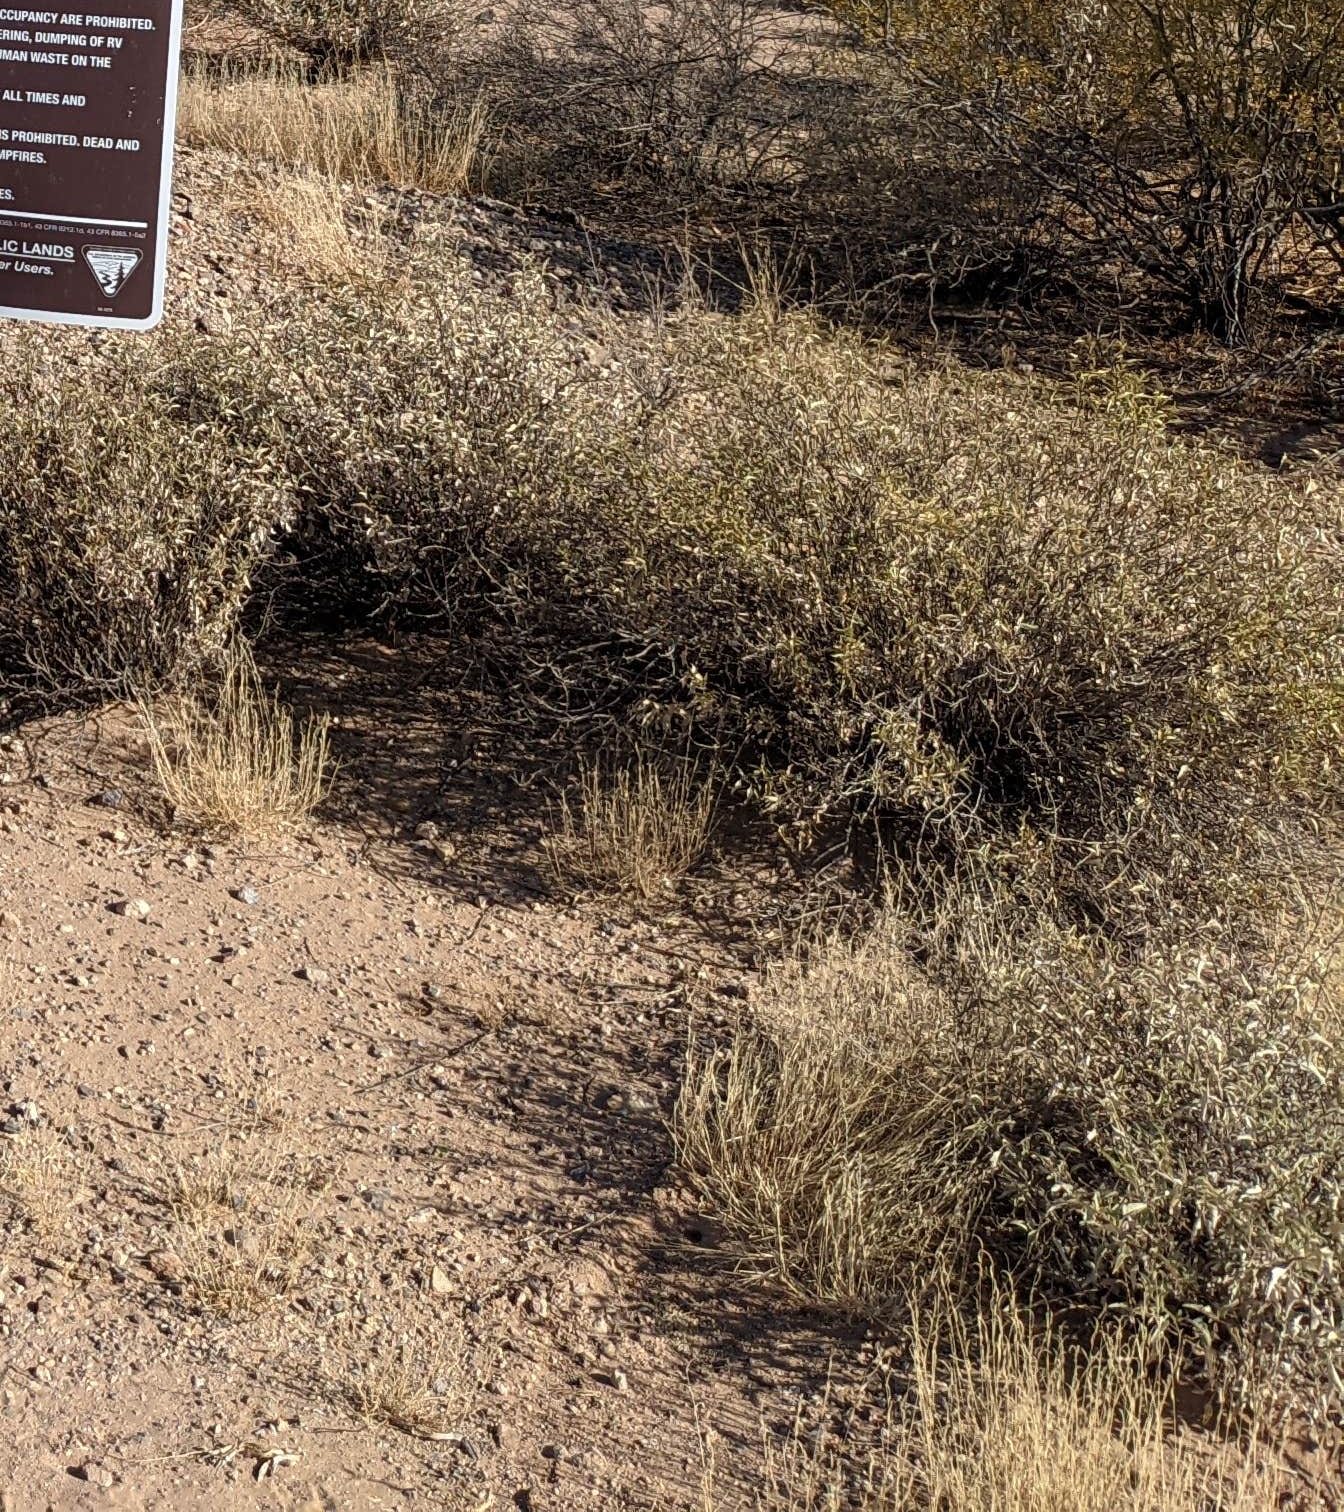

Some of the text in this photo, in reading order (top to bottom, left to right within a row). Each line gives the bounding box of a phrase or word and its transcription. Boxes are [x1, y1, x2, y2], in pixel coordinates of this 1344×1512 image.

[59, 13, 84, 26] ARE
[85, 15, 156, 31] PROHIBITED.
[34, 31, 87, 47] DUMPING
[89, 35, 106, 48] OF
[106, 36, 124, 49] RV
[29, 51, 70, 66] WASTE
[71, 54, 88, 67] ON
[89, 55, 112, 69] THE
[2, 89, 24, 102] ALL
[25, 91, 60, 105] TIMES
[61, 94, 86, 107] AND
[11, 130, 81, 147] PROHIBITED.
[82, 135, 114, 150] DEAD
[114, 138, 141, 152] AND
[22, 241, 75, 258] LANDS
[13, 260, 54, 276] Users.
